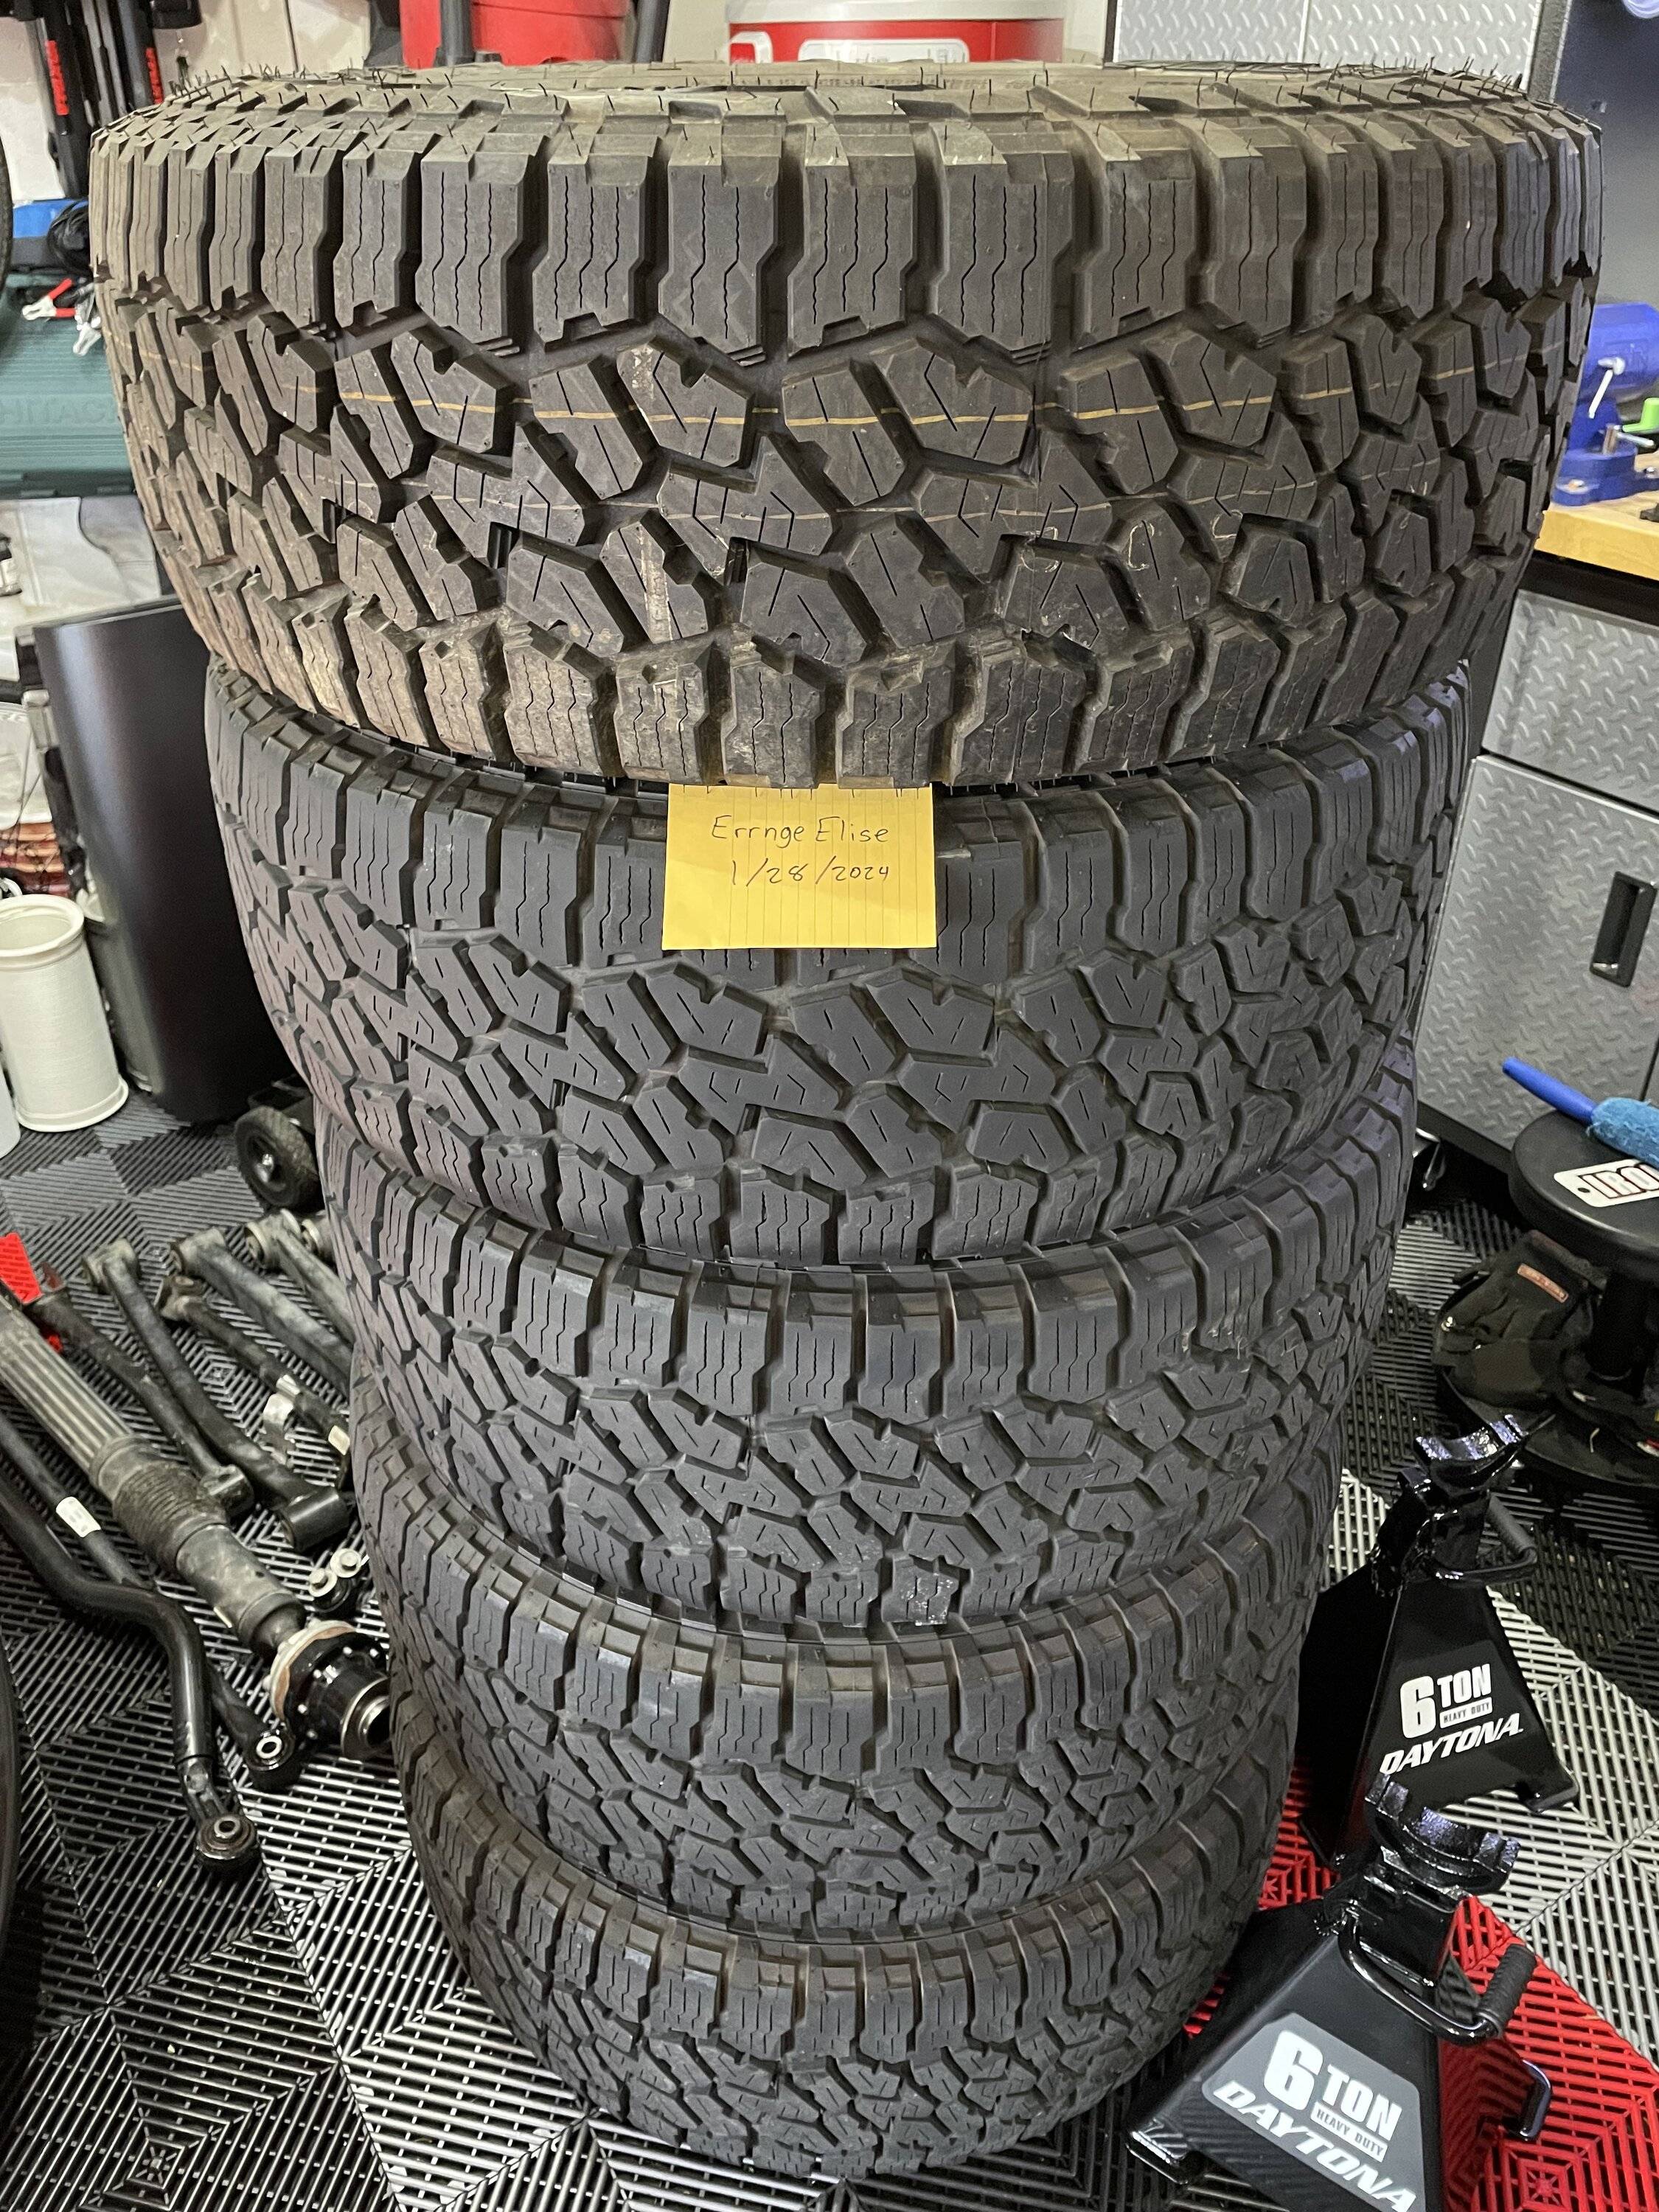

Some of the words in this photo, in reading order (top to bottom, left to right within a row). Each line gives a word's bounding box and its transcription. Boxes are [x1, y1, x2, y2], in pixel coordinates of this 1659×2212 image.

[712, 814, 804, 849] Errnge
[815, 815, 889, 843] Elise
[1399, 1675, 1436, 1739] 6
[1437, 1663, 1492, 1708] TON
[1443, 1709, 1469, 1724] HEAVY
[1470, 1701, 1490, 1715] DUTY
[1379, 1713, 1521, 1775] DAYTONA
[1263, 2029, 1324, 2110] 6
[1322, 2064, 1402, 2141] TON
[1213, 2079, 1416, 2212] DAYTONA
[1316, 2108, 1351, 2136] HEAVY
[1354, 2131, 1385, 2157] DUTY
